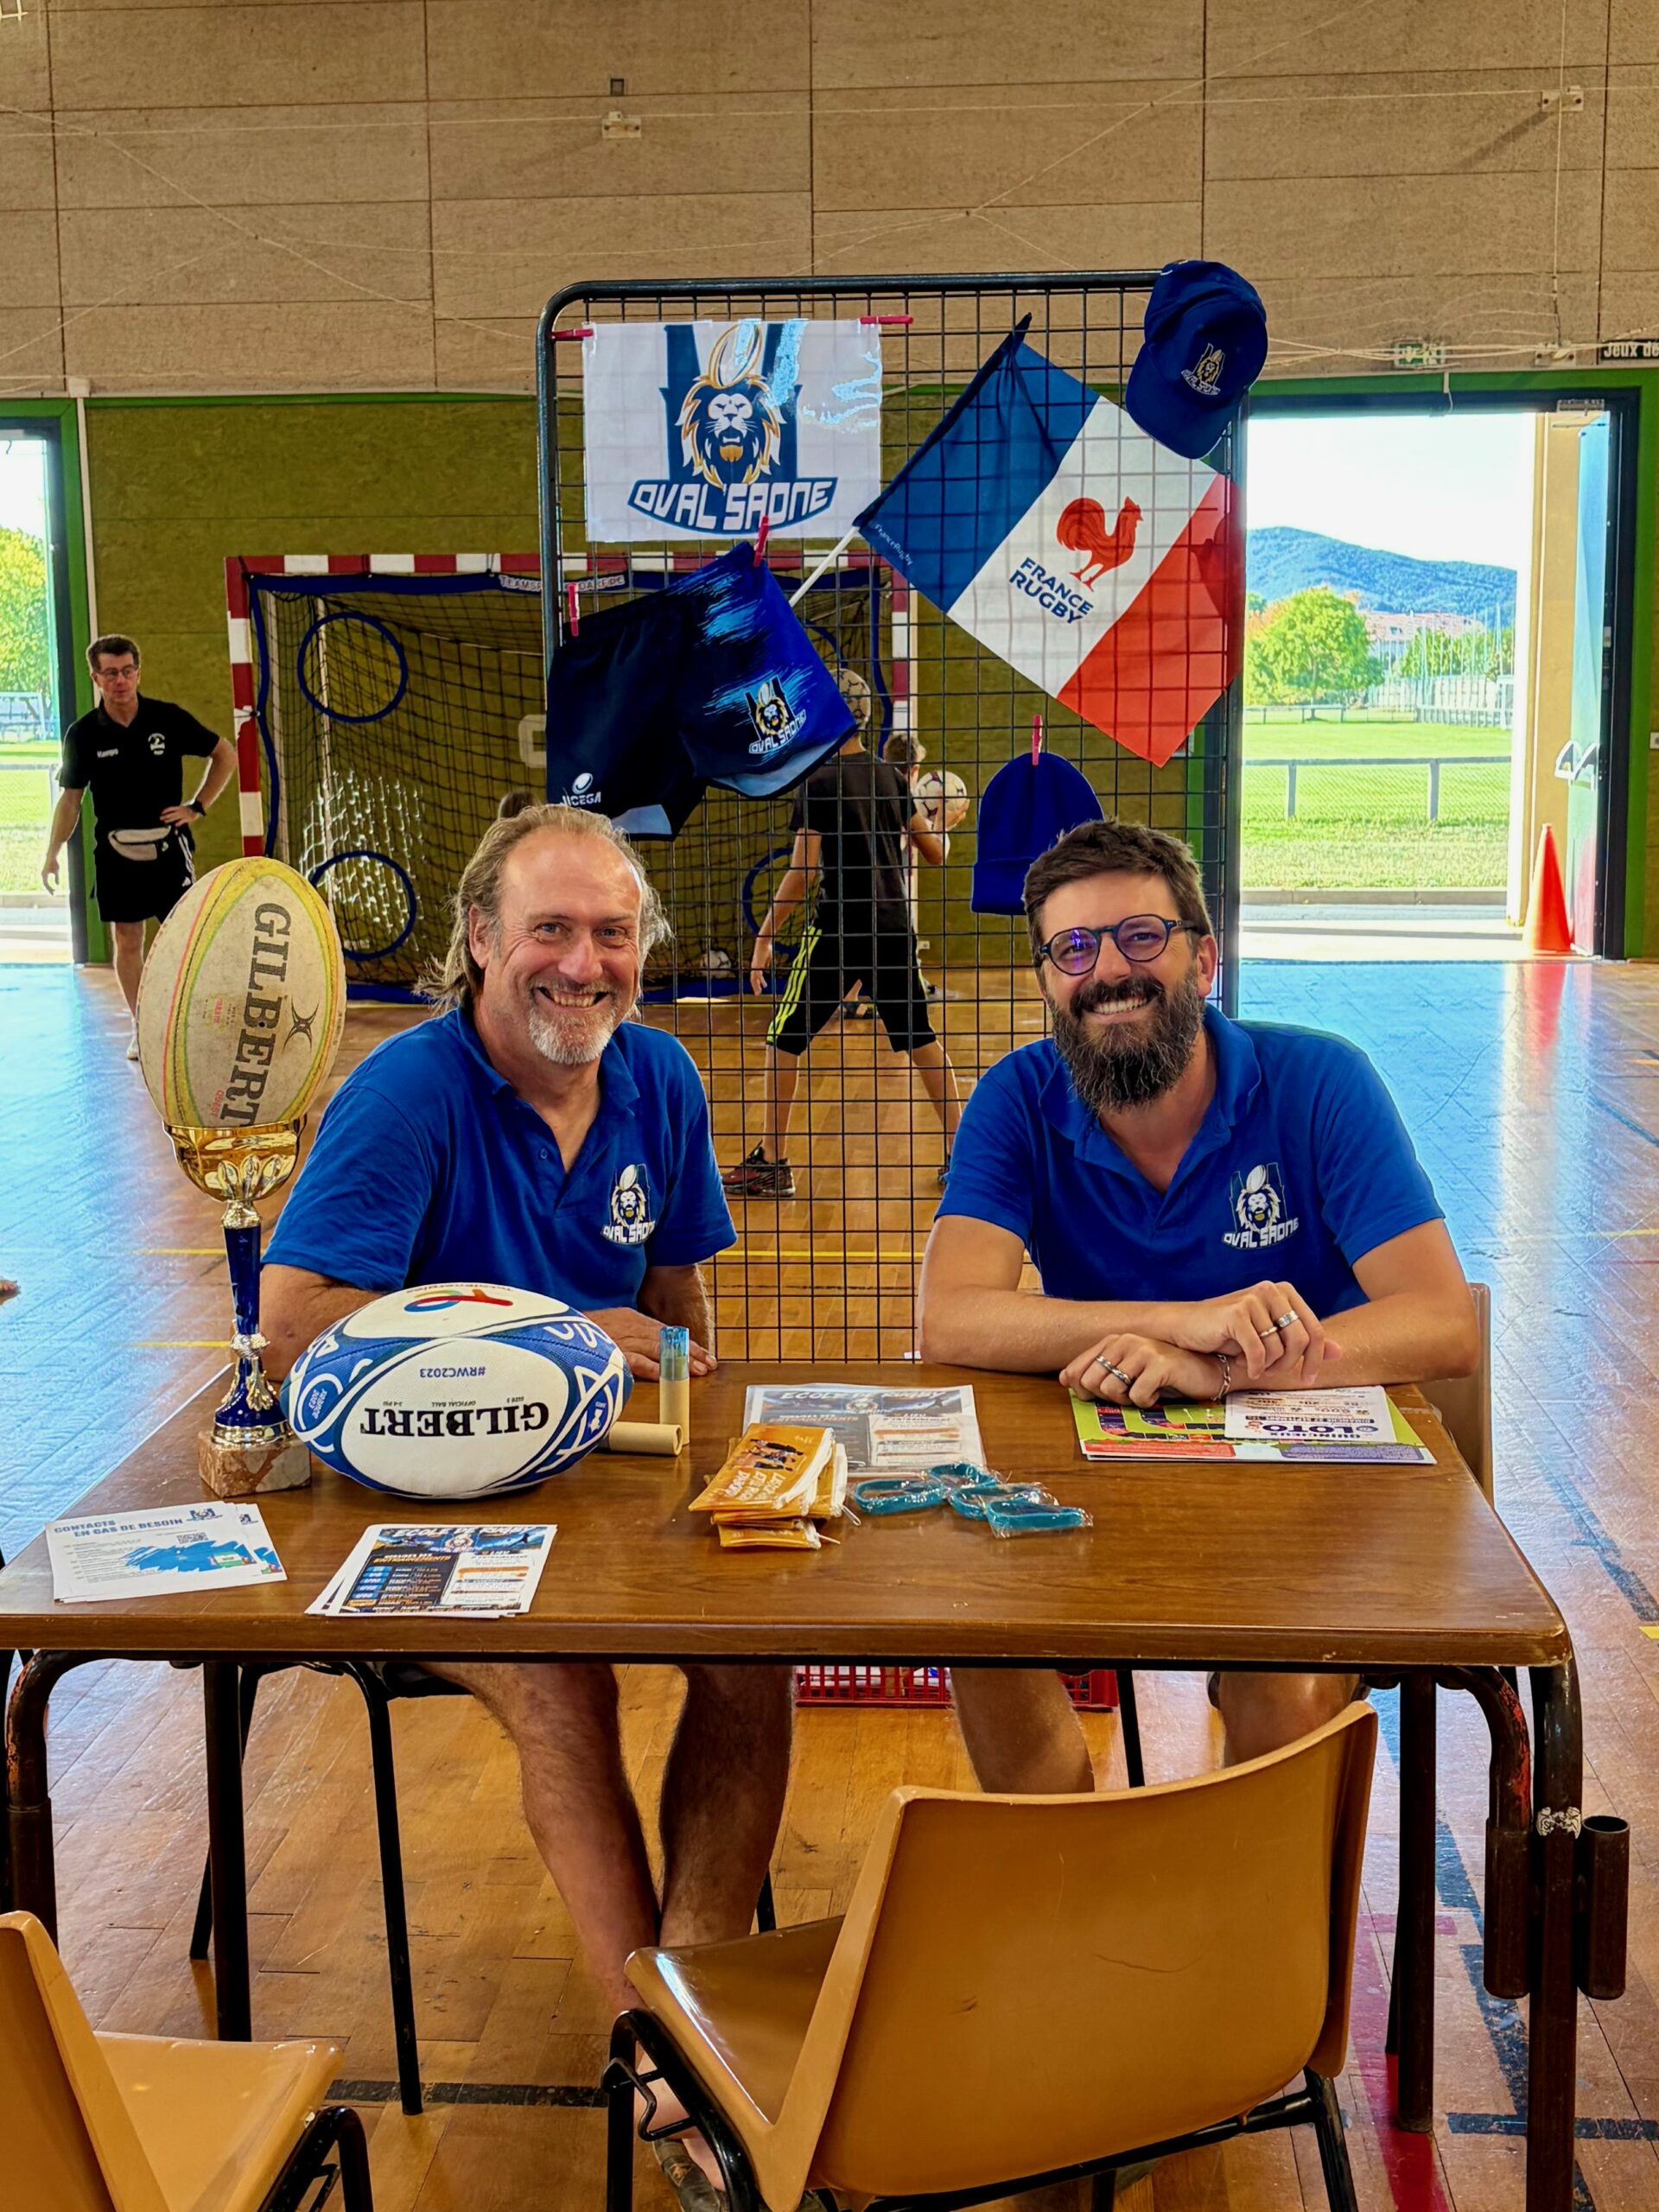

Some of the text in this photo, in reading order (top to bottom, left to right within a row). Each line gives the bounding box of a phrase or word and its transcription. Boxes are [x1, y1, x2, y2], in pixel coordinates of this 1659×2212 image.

[1604, 342, 1637, 357] Jeux
[1020, 556, 1094, 615] FRANCE
[1009, 569, 1083, 624] RUGBY
[219, 902, 291, 1125] GILBERT
[1224, 1217, 1299, 1249] OVAL SAONE
[419, 1366, 486, 1378] #RWC2023
[359, 1402, 550, 1437] GILBERT
[1262, 1425, 1354, 1433] LOTO
[54, 1520, 116, 1534] CONTACTS
[139, 1518, 183, 1529] BESOIN
[392, 1529, 448, 1537] ECOLE
